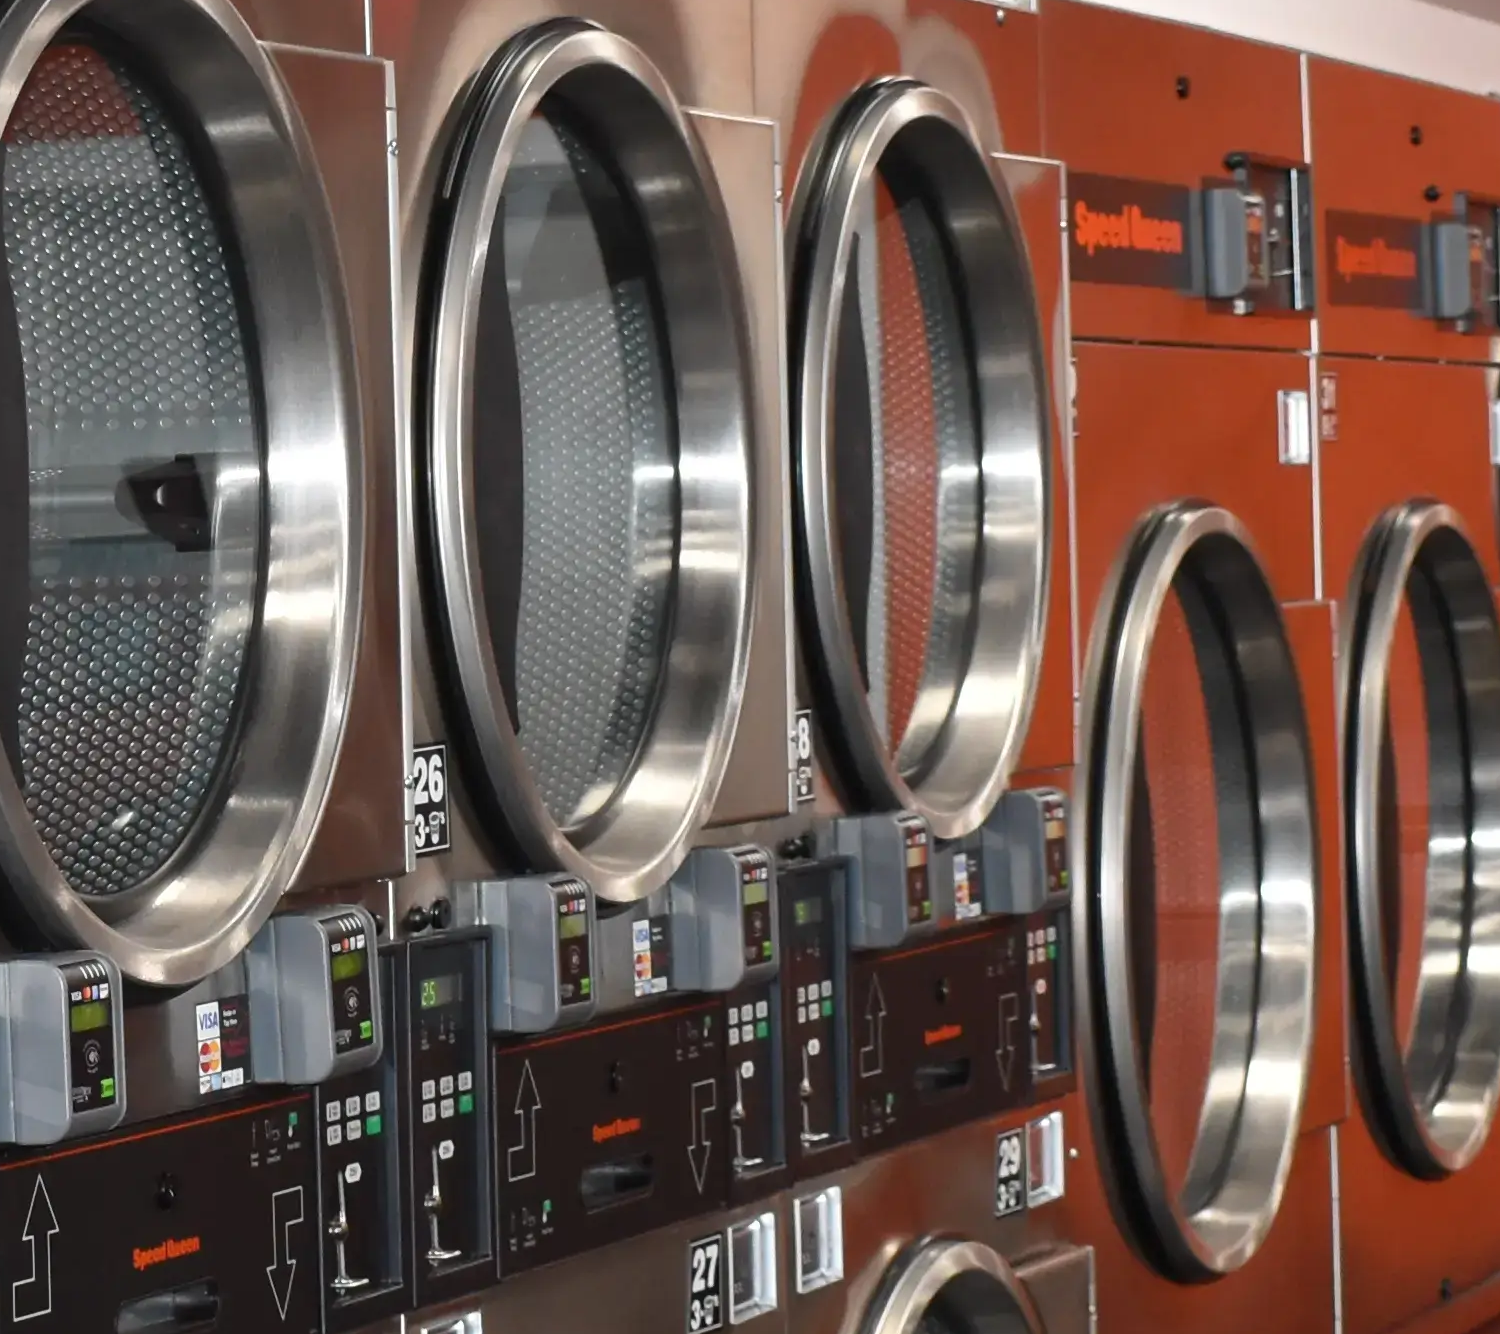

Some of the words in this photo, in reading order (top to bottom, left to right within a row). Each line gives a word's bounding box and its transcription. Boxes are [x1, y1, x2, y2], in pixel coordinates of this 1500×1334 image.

[1075, 200, 1130, 257] Speed
[414, 754, 444, 805] 26
[692, 1243, 718, 1293] 27
